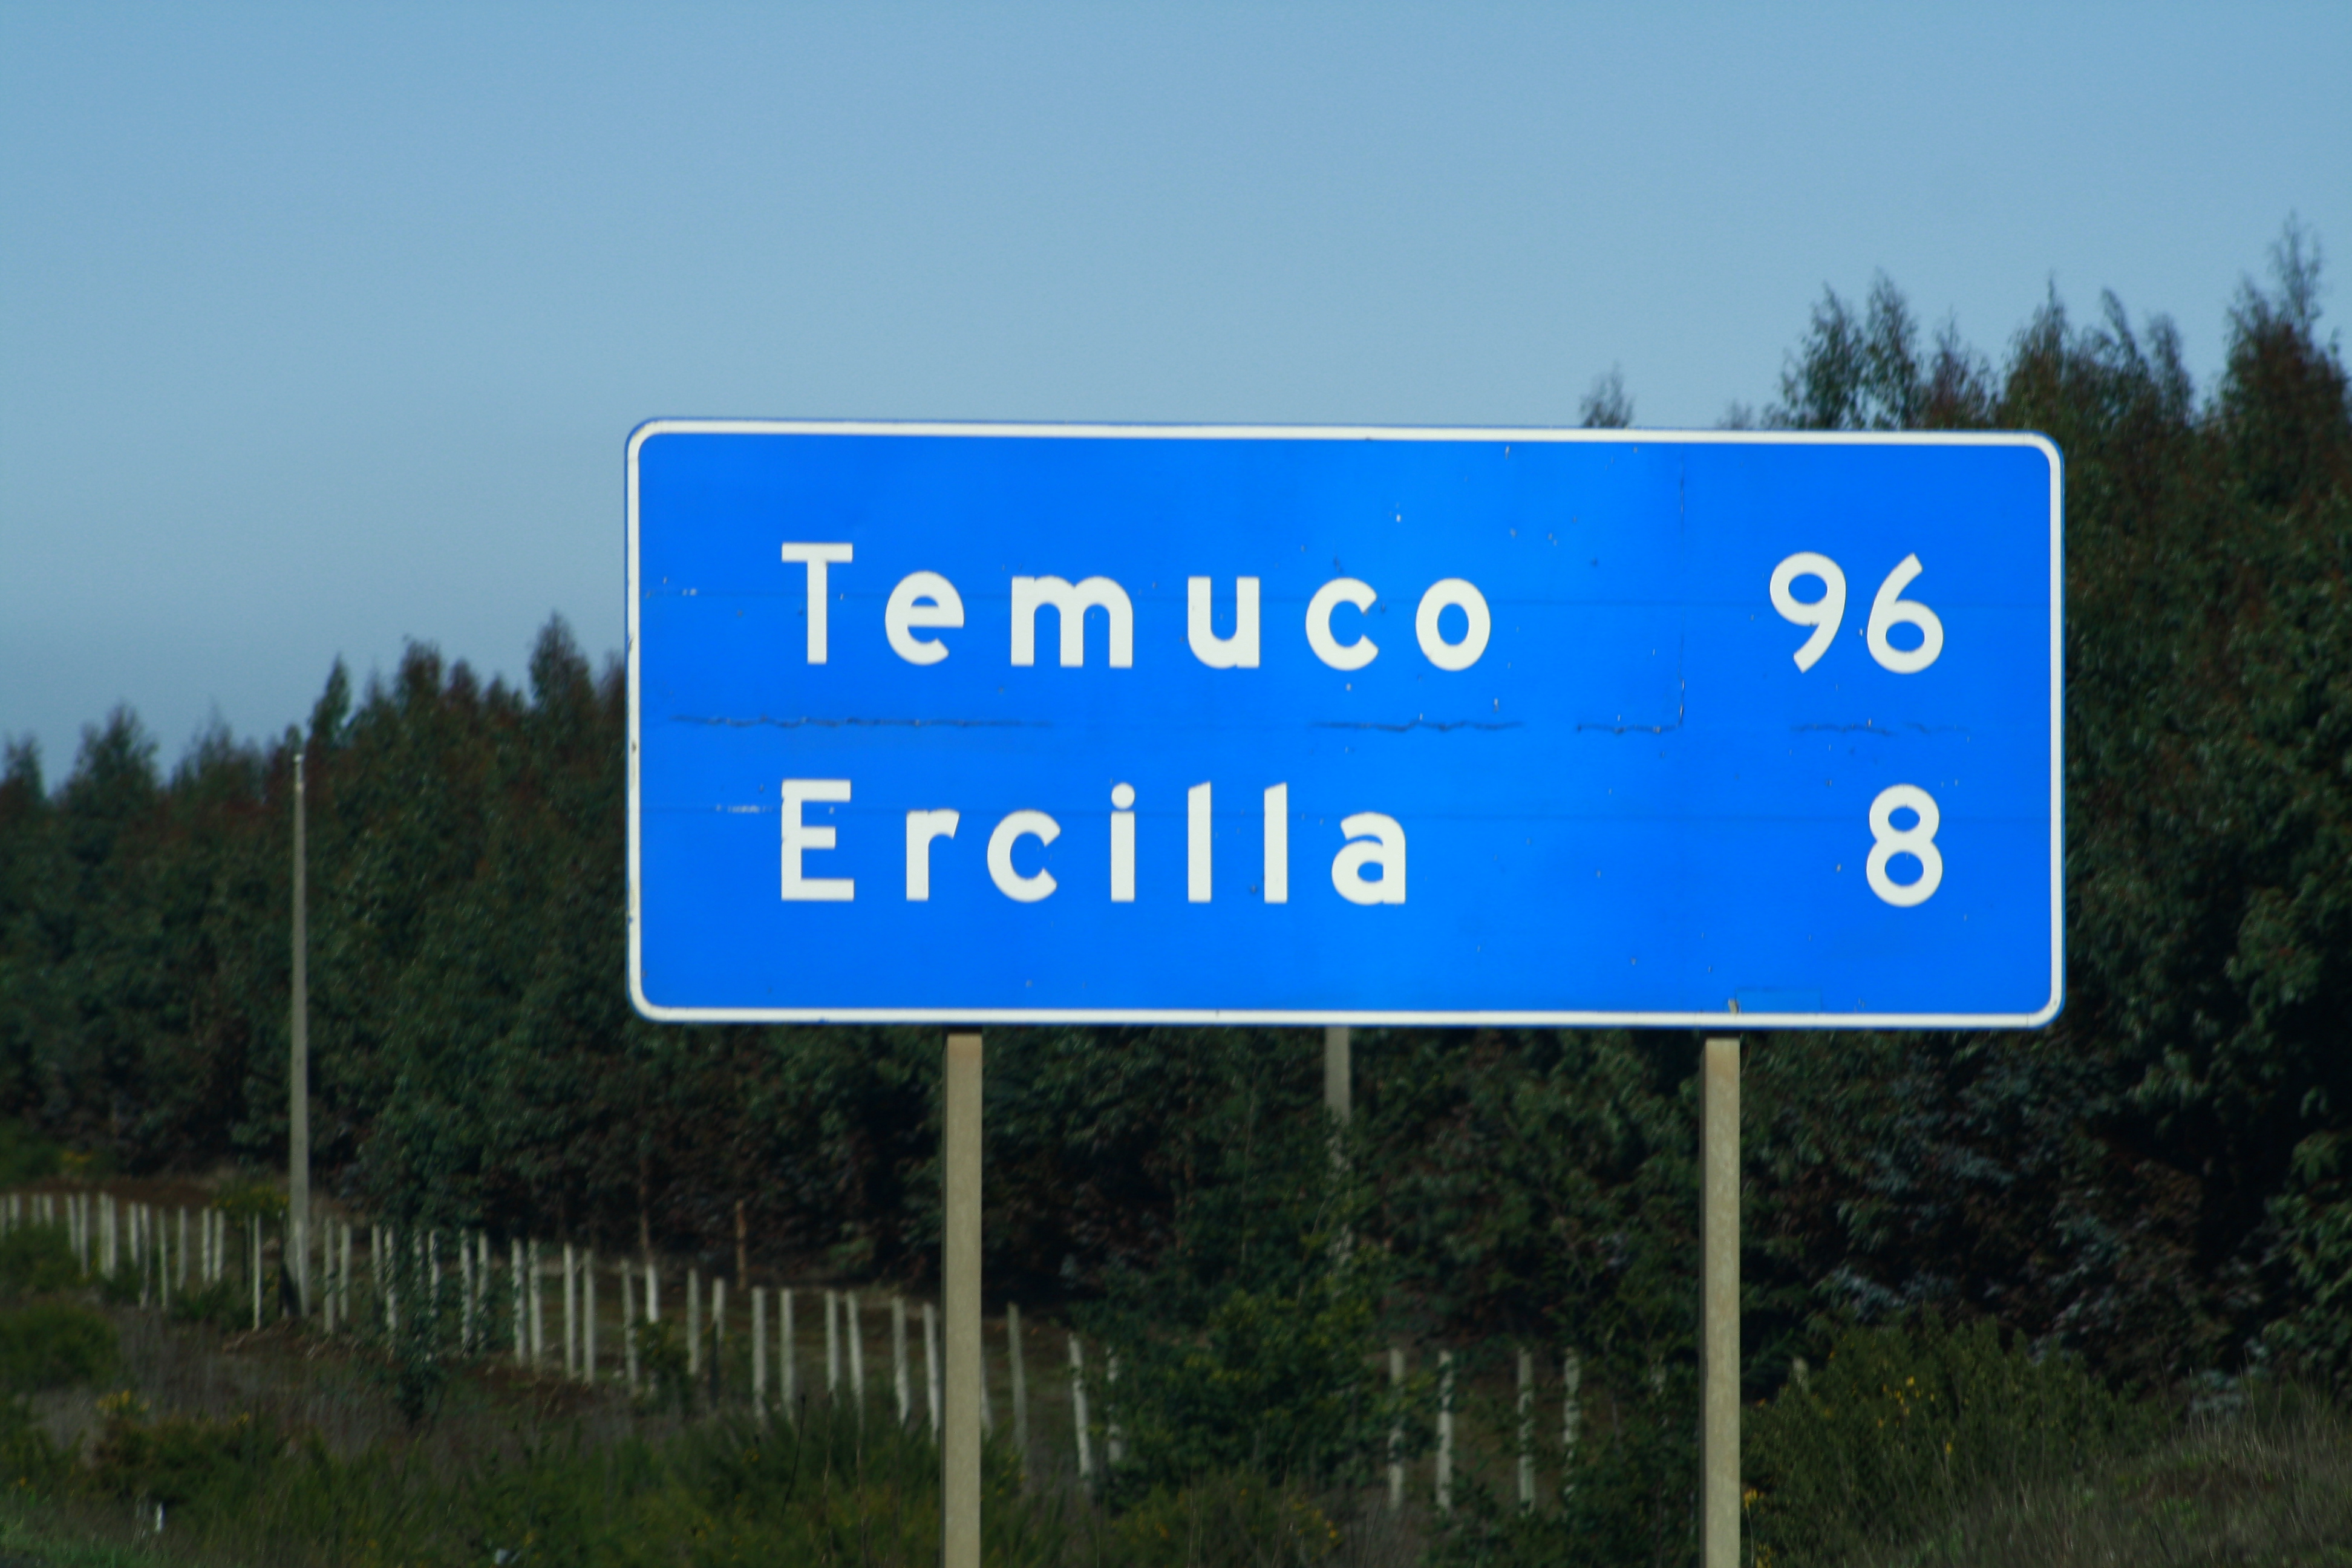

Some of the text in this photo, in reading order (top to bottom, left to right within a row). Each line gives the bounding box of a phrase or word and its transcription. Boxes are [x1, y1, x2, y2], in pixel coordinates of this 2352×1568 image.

[780, 542, 1944, 674] Temuco 96
[780, 779, 1944, 907] Ercilla 8
